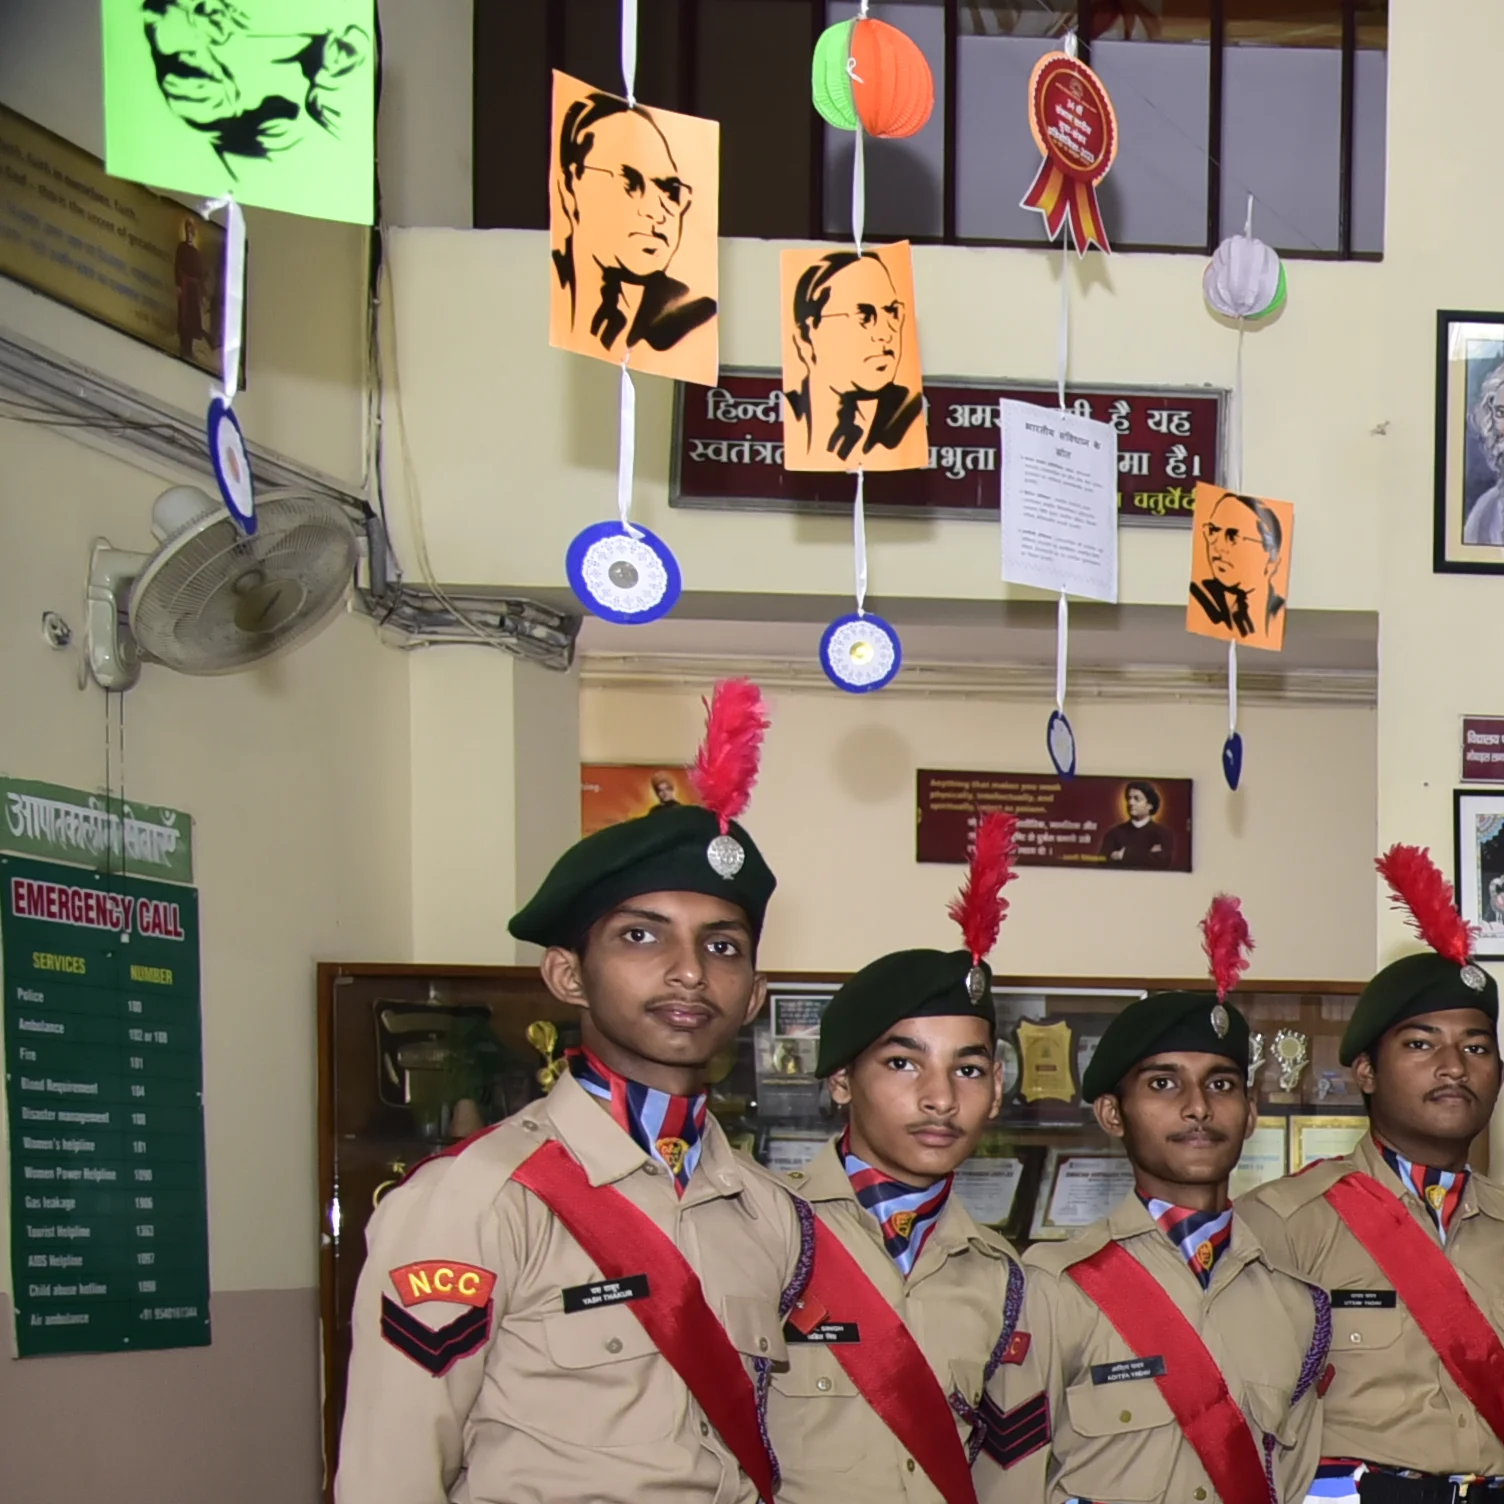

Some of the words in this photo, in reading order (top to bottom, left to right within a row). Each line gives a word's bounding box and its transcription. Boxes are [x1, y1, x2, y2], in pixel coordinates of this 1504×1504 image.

[1147, 409, 1191, 436] यह
[1165, 443, 1201, 478] है।
[11, 876, 135, 934] EMERGENCY
[137, 898, 185, 942] CALL
[32, 951, 87, 975] SERVICES
[129, 964, 173, 985] NUMBER
[17, 987, 44, 1003] Police
[18, 1017, 65, 1035] Ambulance
[19, 1046, 37, 1062] Fire
[20, 1076, 45, 1092] Blood
[46, 1078, 99, 1095] Requirement
[21, 1106, 56, 1121] Disaster
[57, 1111, 110, 1125] management
[62, 1138, 96, 1154] helpline
[24, 1166, 54, 1180] Women
[56, 1167, 82, 1181] Power
[83, 1167, 117, 1183] Helpline
[24, 1195, 41, 1209] Gas
[42, 1196, 76, 1212] leakage
[26, 1225, 55, 1238] Tourist
[56, 1226, 91, 1240] Helpline
[49, 1254, 83, 1268] Helpline
[29, 1284, 51, 1297] Child
[53, 1284, 77, 1296] abuse
[407, 1267, 480, 1298] NCC
[30, 1313, 42, 1326] Air
[45, 1313, 89, 1326] ambulance
